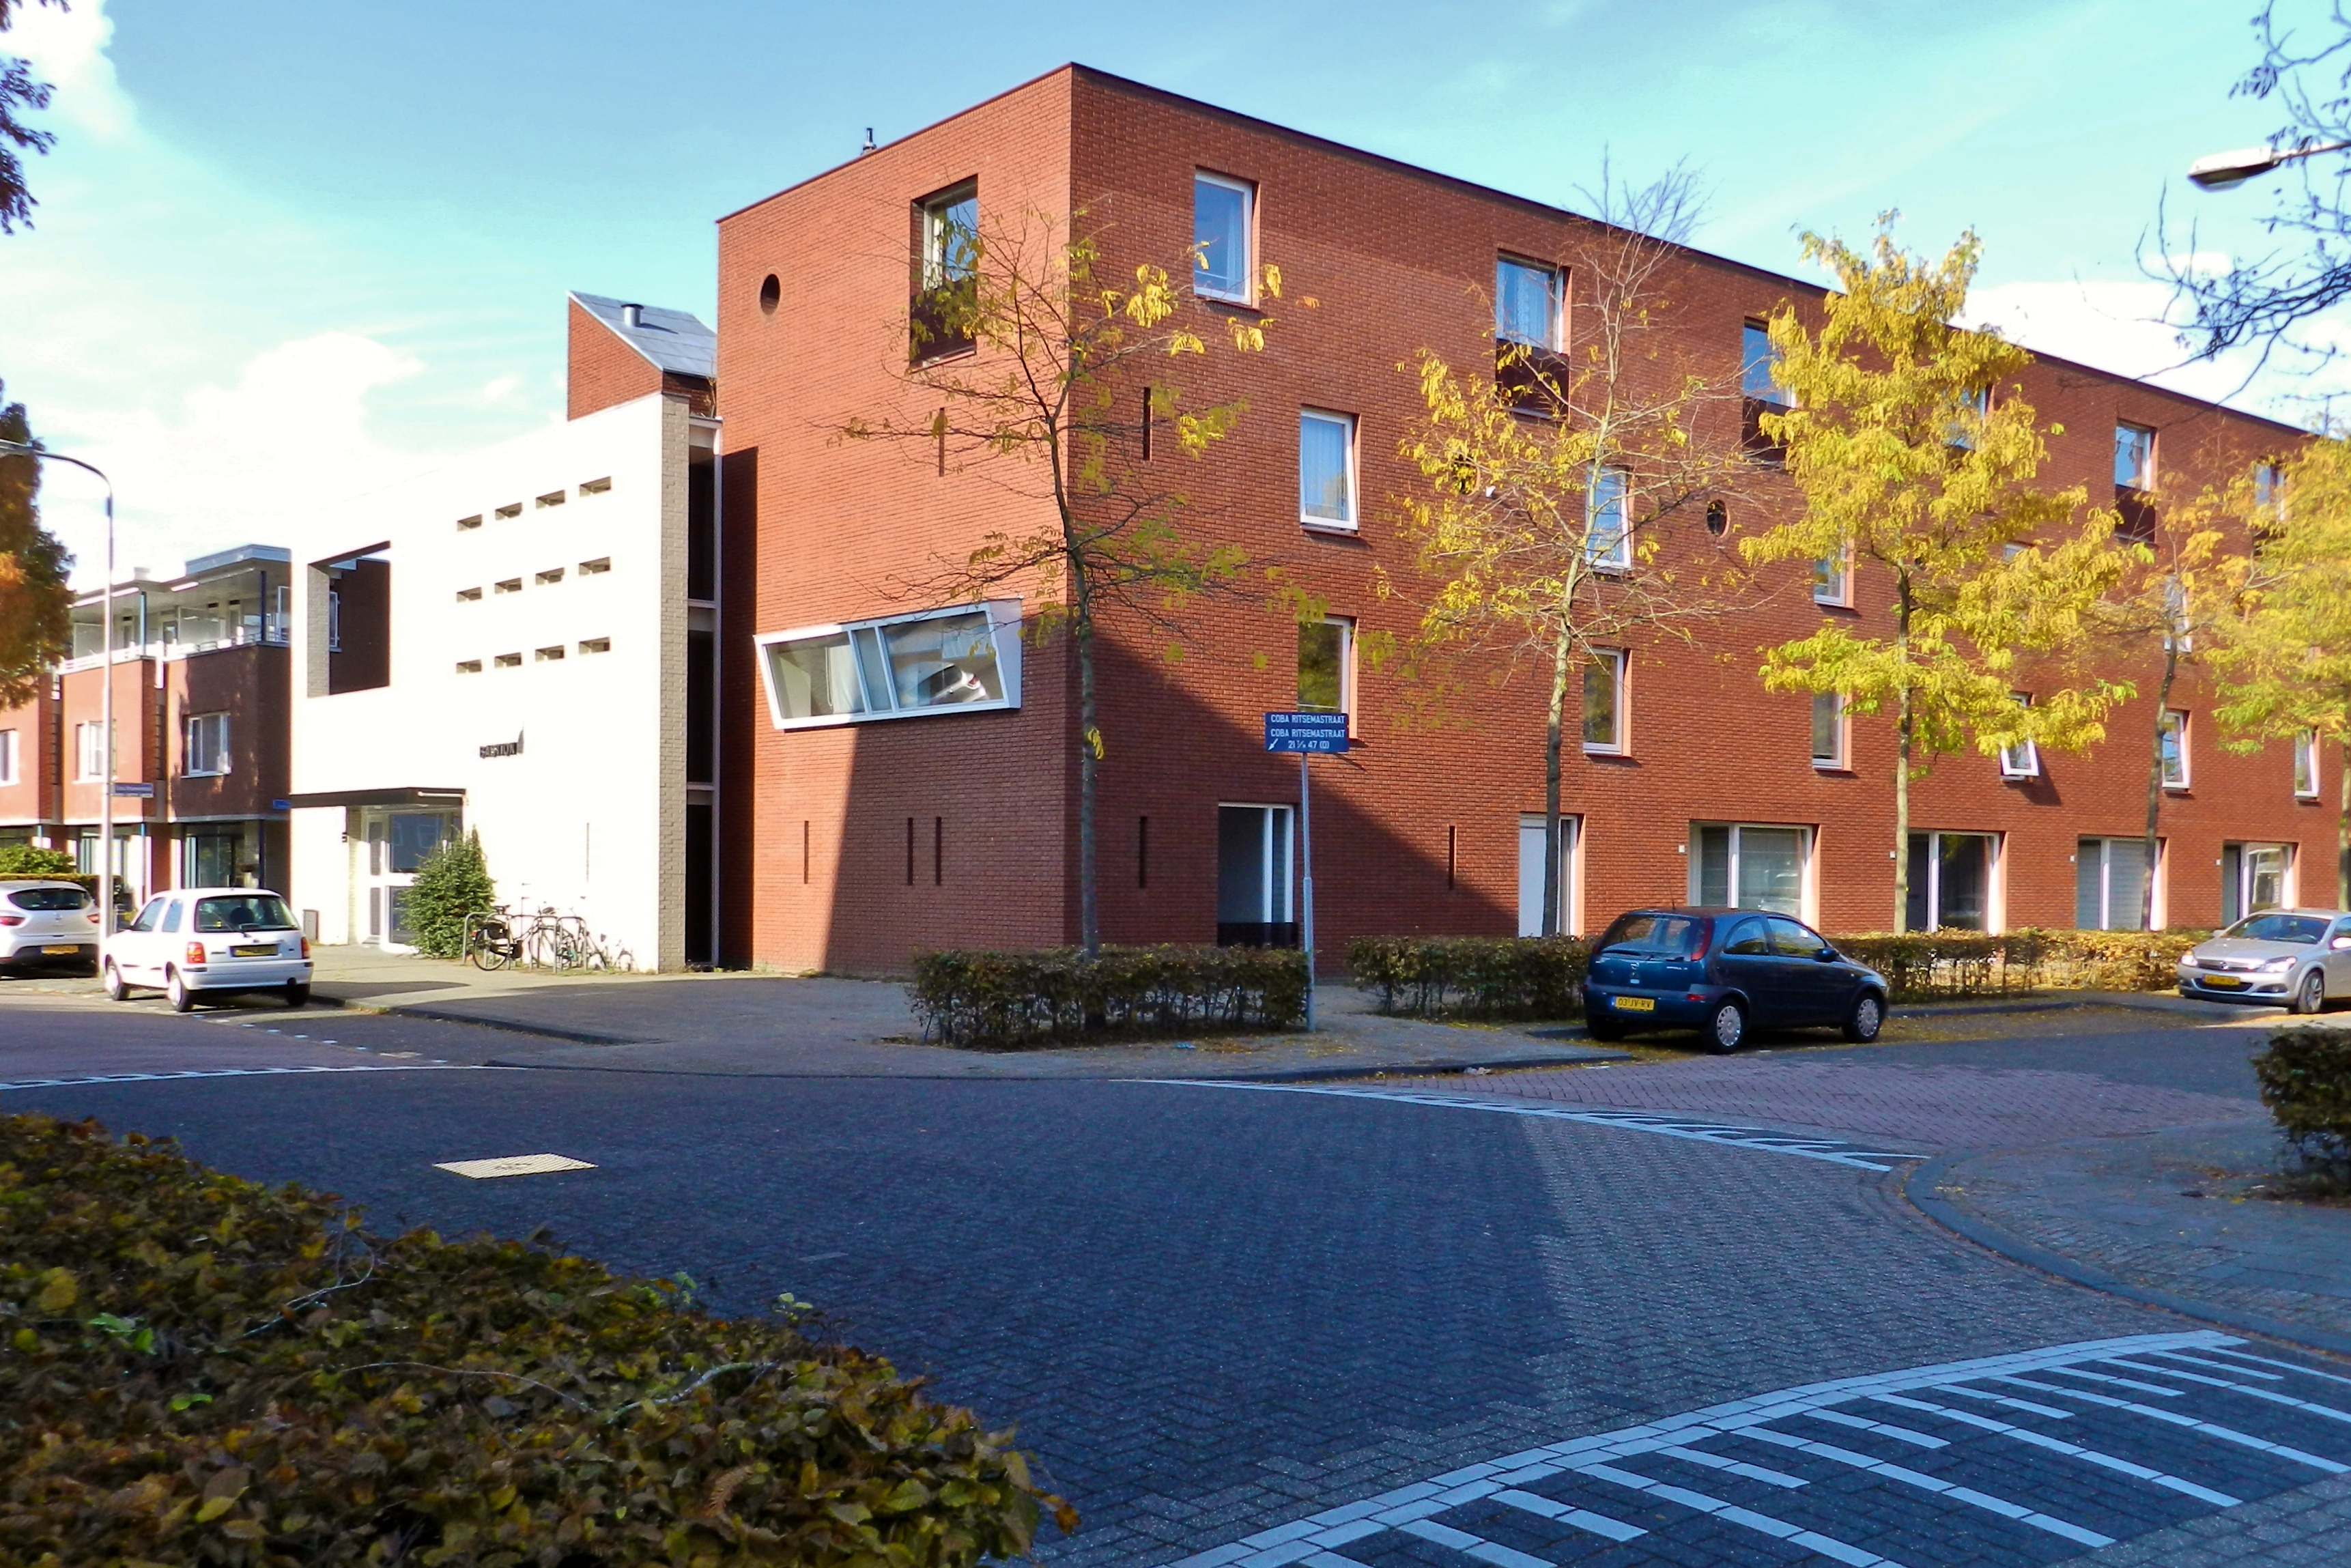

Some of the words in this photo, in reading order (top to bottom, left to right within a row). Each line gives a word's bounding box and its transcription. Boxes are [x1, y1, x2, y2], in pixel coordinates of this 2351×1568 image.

[1270, 714, 1290, 723] COBA
[1292, 715, 1345, 724] RITSEMASTRAAT
[1270, 728, 1290, 737] COBA
[1292, 728, 1345, 737] RITSEMASTRAAT
[1288, 740, 1296, 749] 21
[1308, 740, 1317, 749] 47
